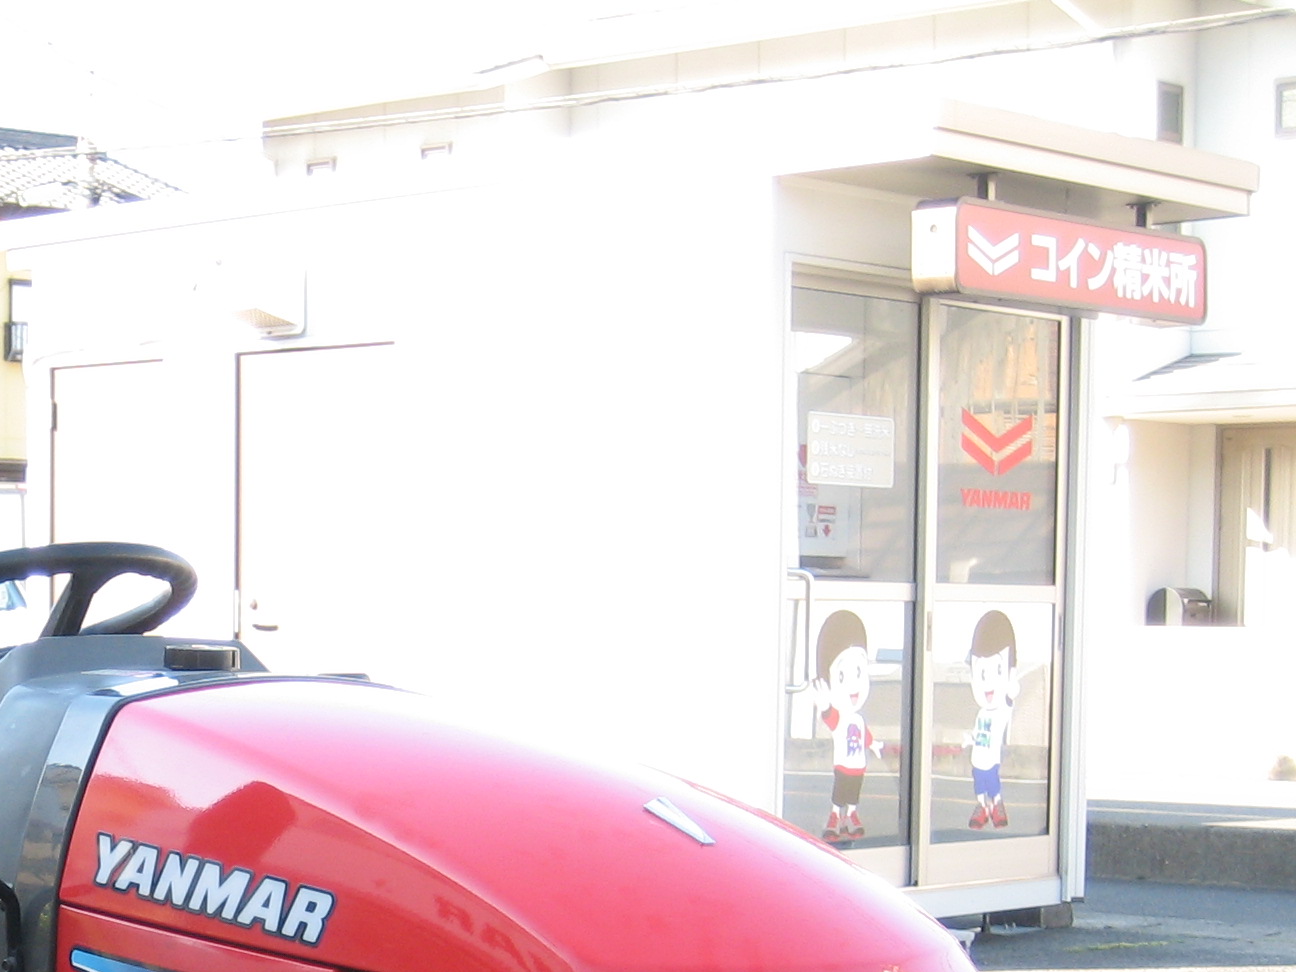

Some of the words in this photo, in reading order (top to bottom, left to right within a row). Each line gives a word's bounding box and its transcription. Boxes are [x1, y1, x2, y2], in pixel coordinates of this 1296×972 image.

[1030, 234, 1197, 308] コイン精米所
[960, 488, 1032, 511] YANMAR
[94, 832, 335, 946] YANMAR
